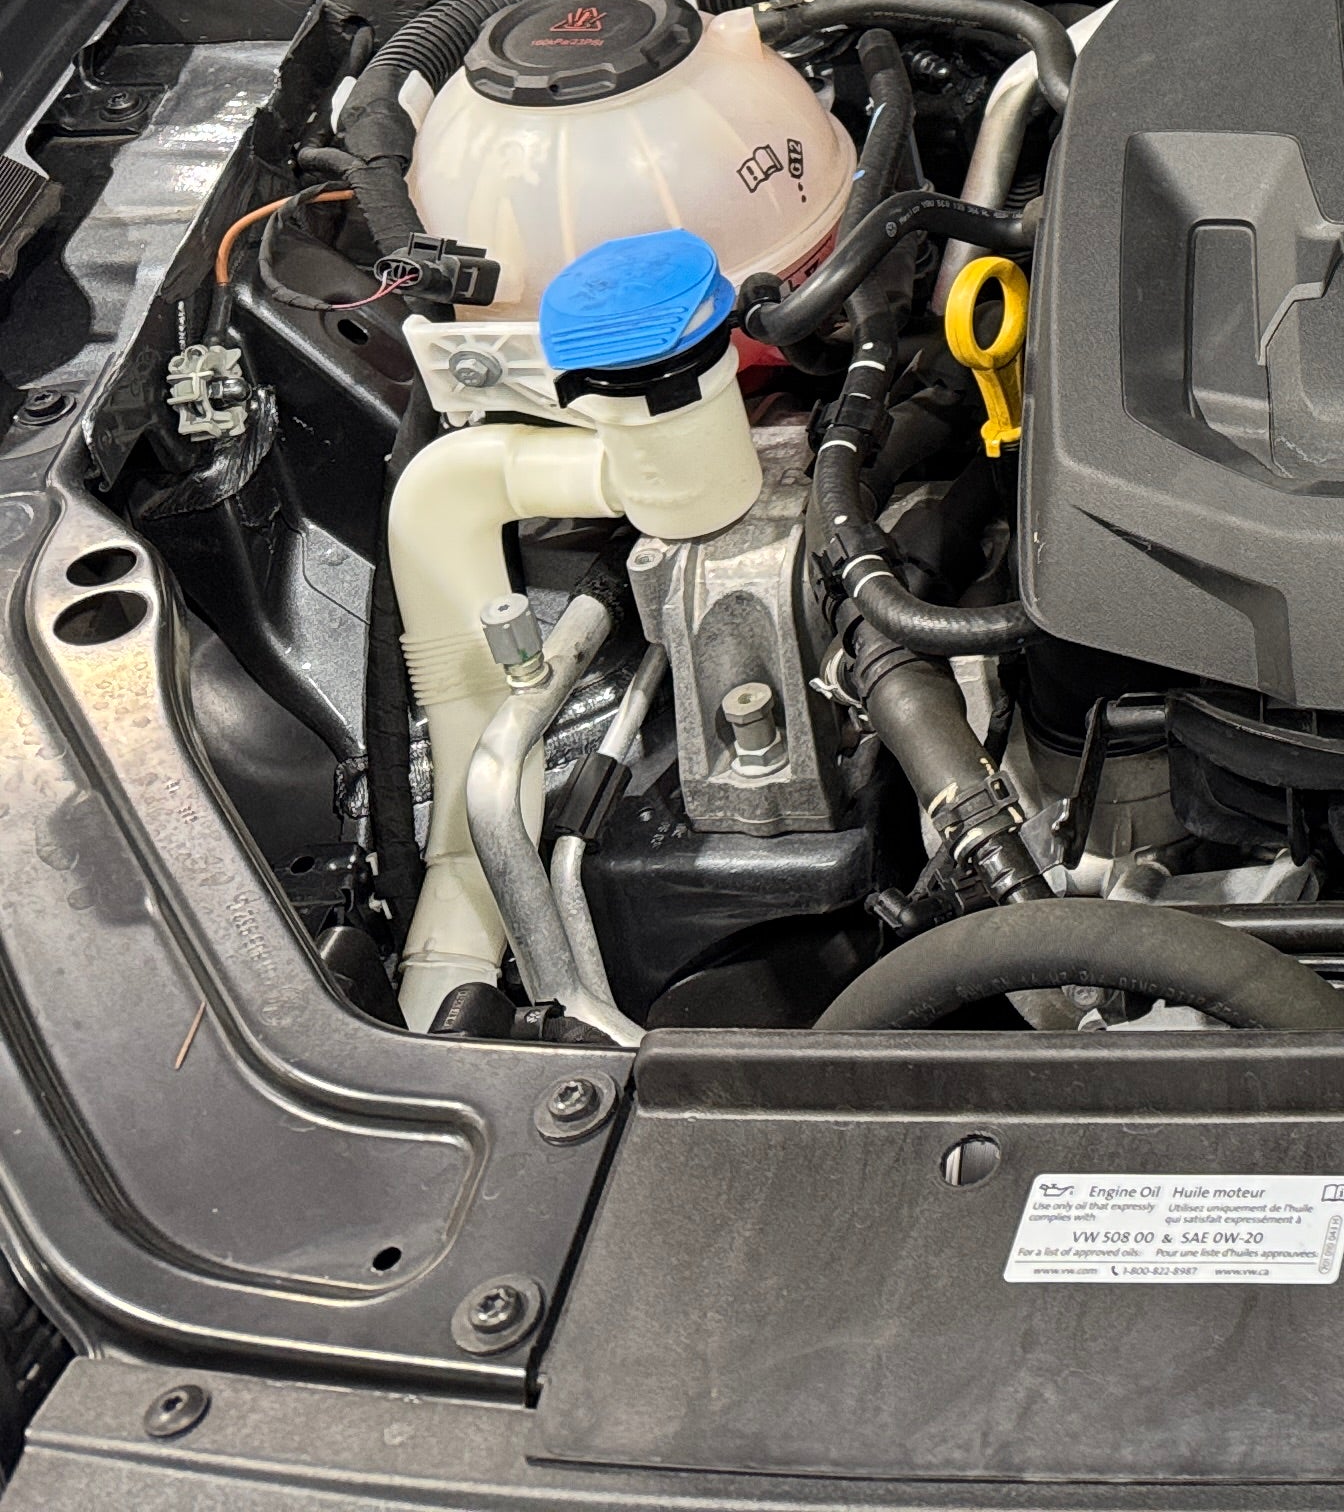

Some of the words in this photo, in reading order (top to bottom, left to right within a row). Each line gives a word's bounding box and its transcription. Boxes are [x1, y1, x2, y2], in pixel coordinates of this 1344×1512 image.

[1088, 1185, 1138, 1201] Engine
[1139, 1185, 1162, 1199] Oil
[1172, 1185, 1211, 1199] Huile
[1212, 1186, 1267, 1199] moteur
[1032, 1201, 1052, 1211] Use
[1052, 1201, 1074, 1213] only
[1074, 1201, 1089, 1211] oil
[1088, 1201, 1110, 1214] that
[1110, 1201, 1157, 1214] expressly
[1028, 1212, 1072, 1224] complies
[1073, 1212, 1097, 1222] with
[1072, 1231, 1101, 1244] VW
[1101, 1231, 1131, 1244] 508
[1133, 1231, 1155, 1244] 00
[1161, 1233, 1173, 1244] &
[1180, 1231, 1210, 1244] SAE
[1212, 1231, 1264, 1245] 0W-20
[1122, 1266, 1199, 1276] 1-800-822-8987
